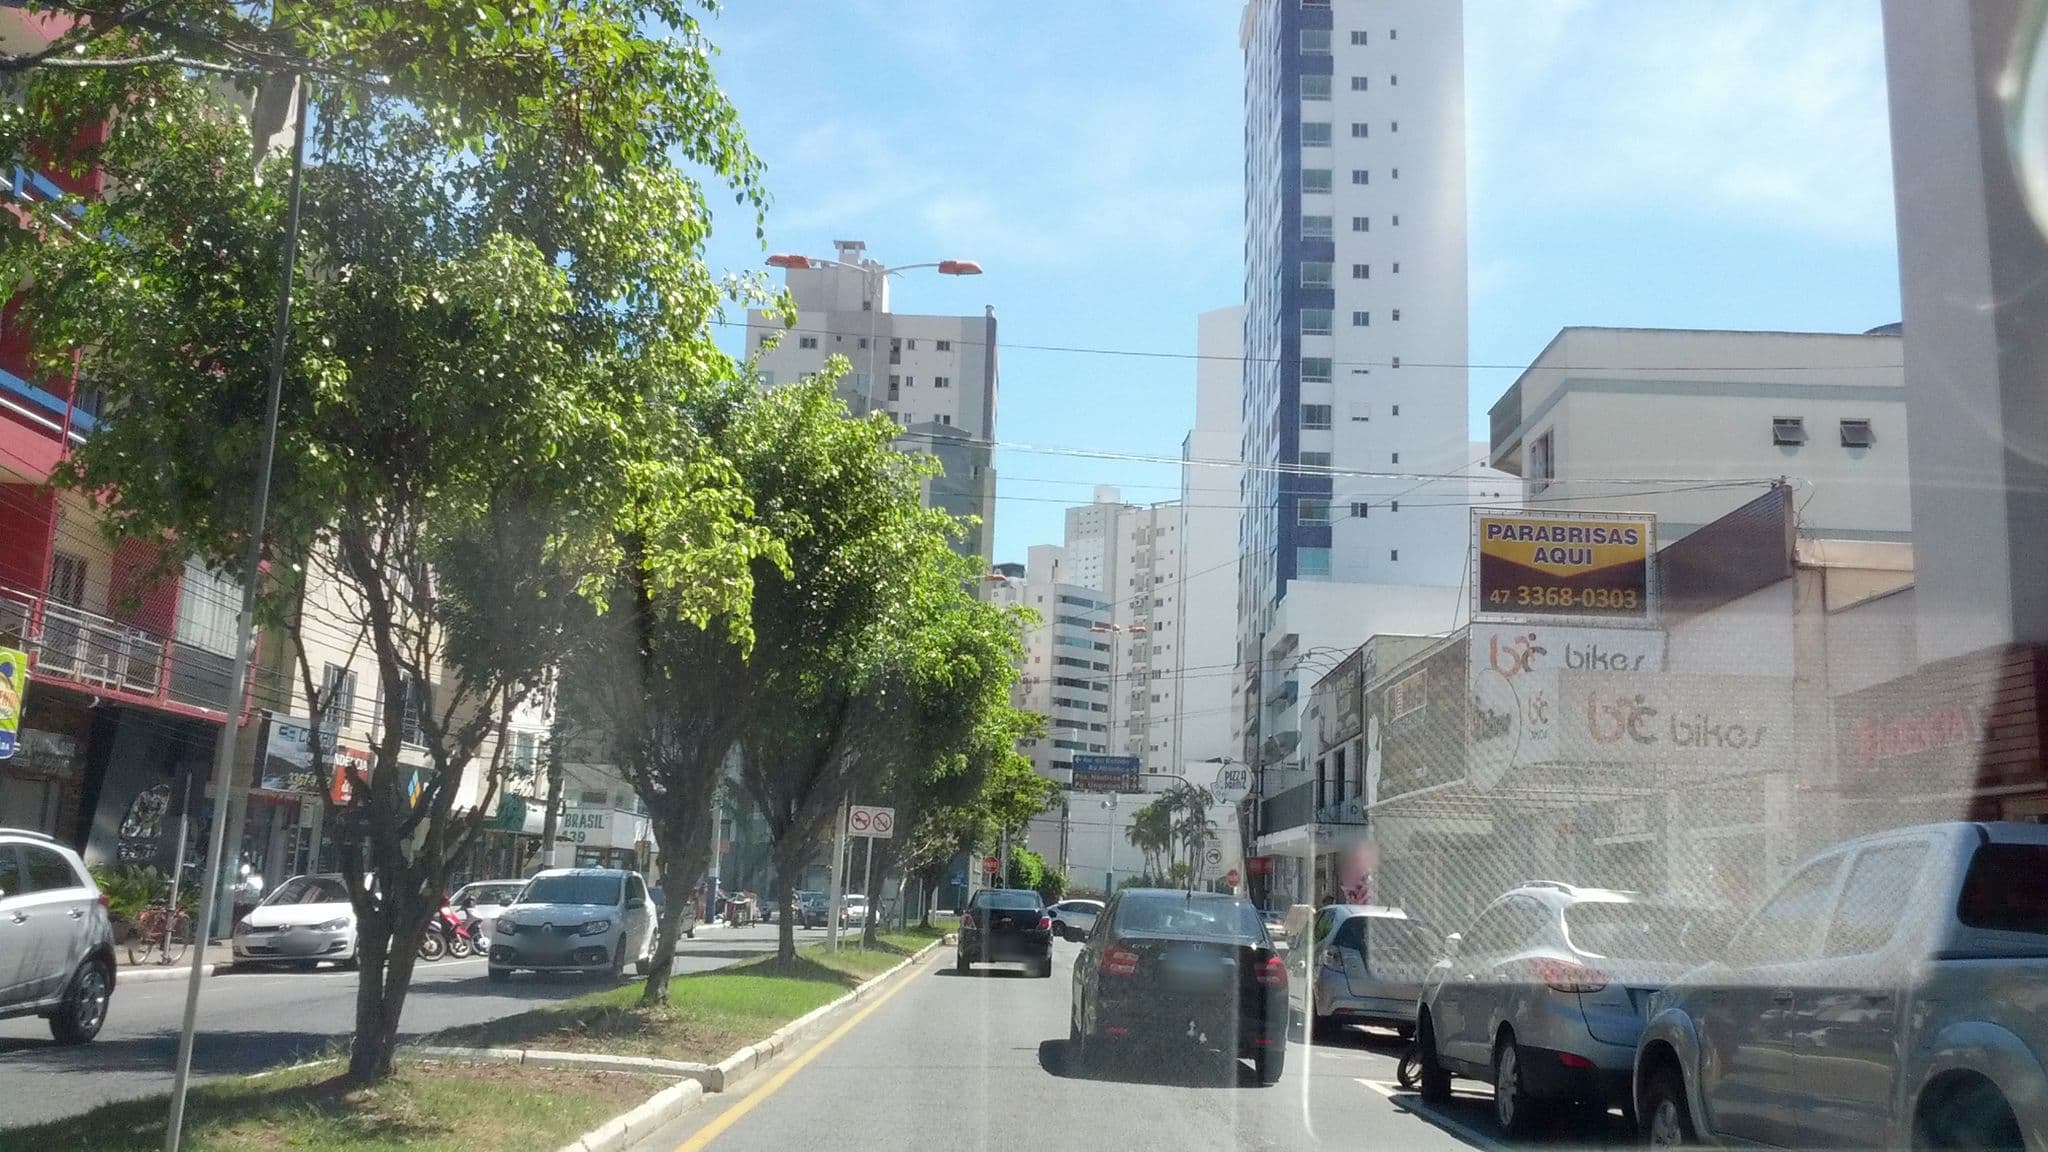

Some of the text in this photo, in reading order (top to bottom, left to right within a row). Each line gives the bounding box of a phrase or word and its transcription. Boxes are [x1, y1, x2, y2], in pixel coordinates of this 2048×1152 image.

[1487, 523, 1639, 545] PARABRISAS
[1533, 547, 1593, 567] AQUI
[1490, 585, 1638, 609] 47 3368-0303
[1564, 642, 1646, 672] bikes
[1670, 713, 1768, 749] bikes
[564, 813, 605, 829] BRASIL
